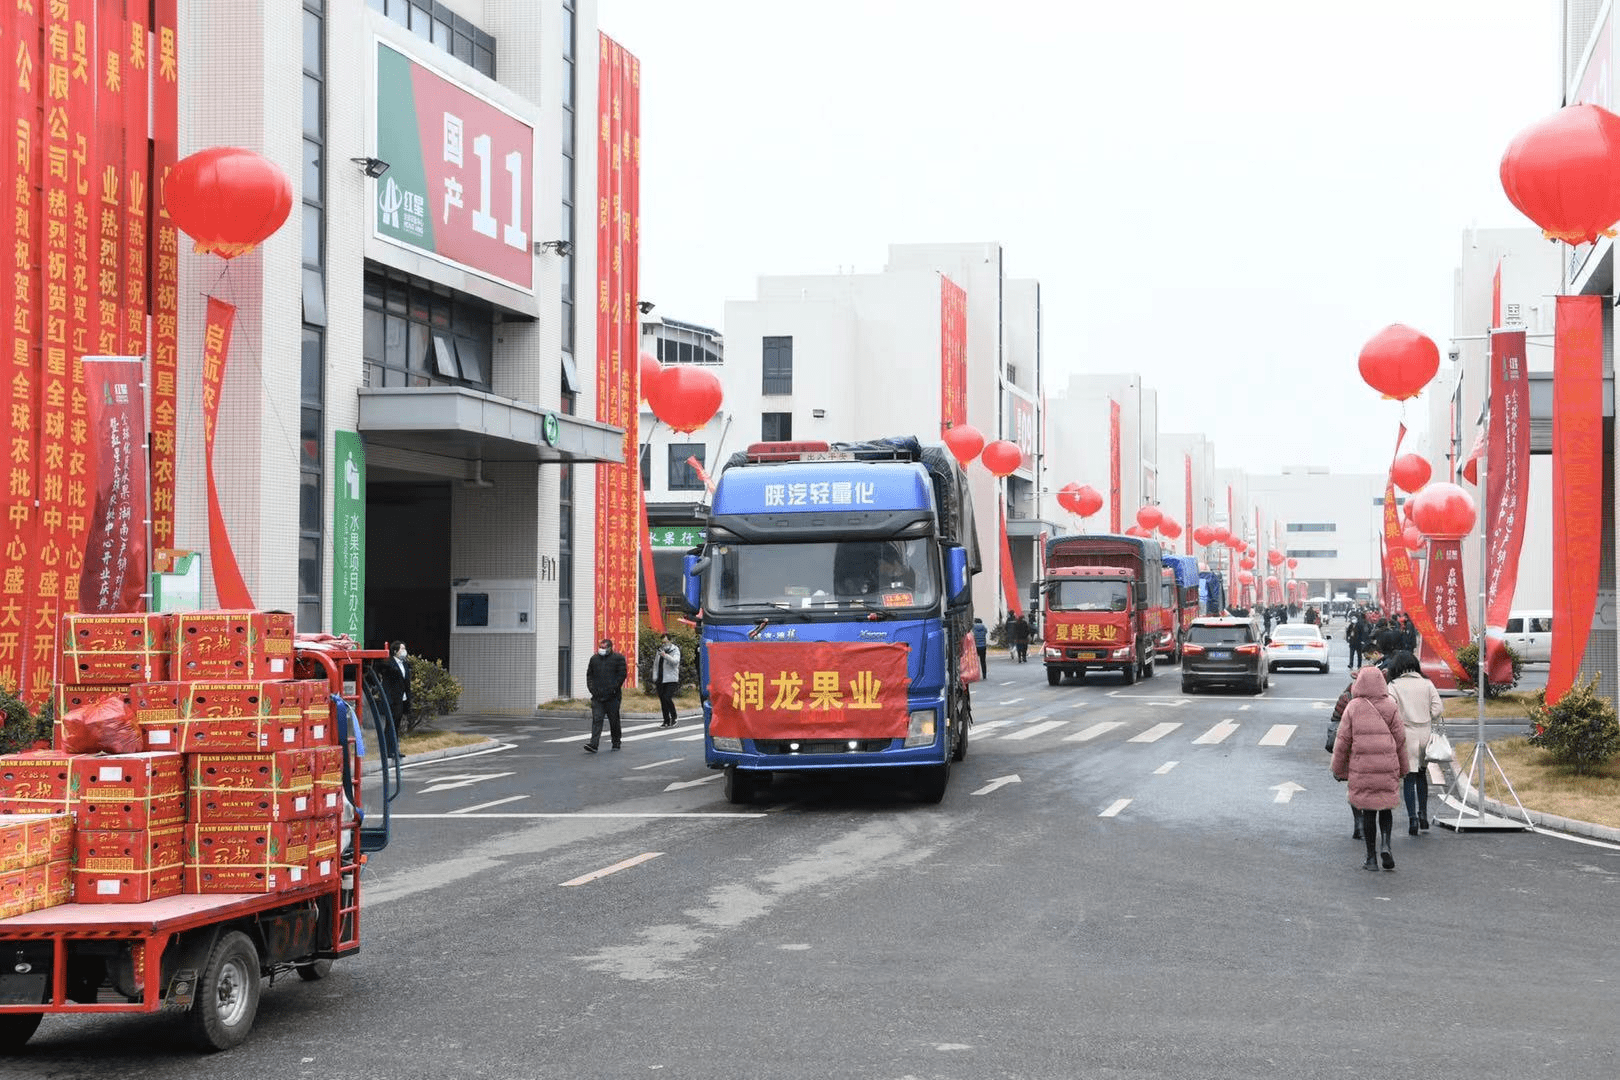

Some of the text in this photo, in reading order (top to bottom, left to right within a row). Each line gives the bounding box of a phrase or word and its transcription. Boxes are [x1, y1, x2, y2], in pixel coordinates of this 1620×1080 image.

[444, 111, 464, 225] 国产
[472, 134, 528, 252] 11
[765, 482, 874, 507] 陕汽轻量化
[732, 670, 883, 711] 润龙果业
